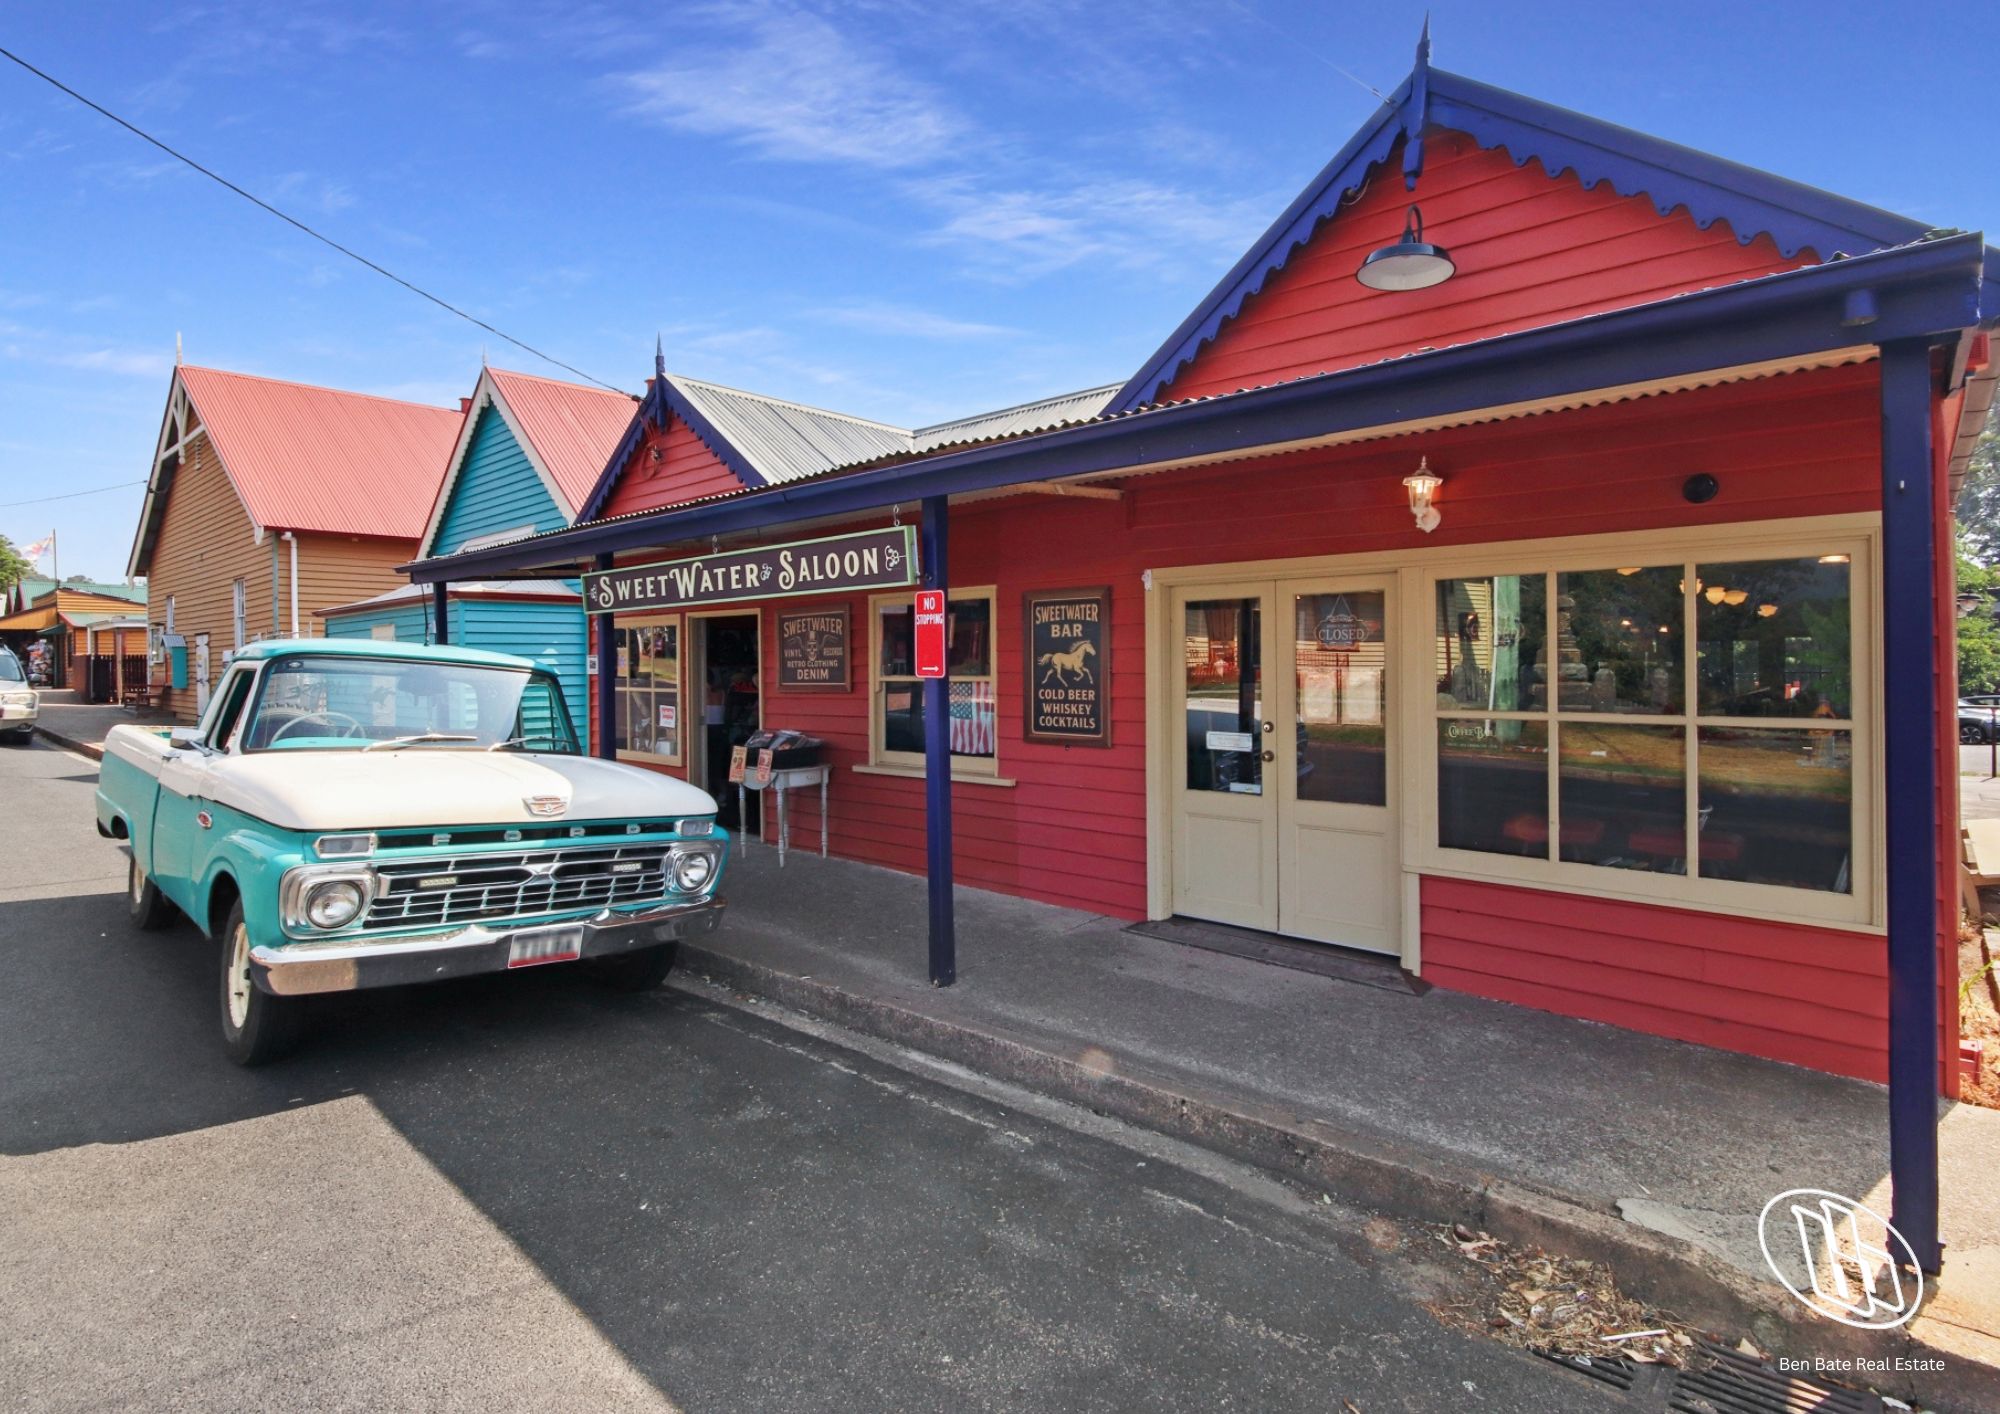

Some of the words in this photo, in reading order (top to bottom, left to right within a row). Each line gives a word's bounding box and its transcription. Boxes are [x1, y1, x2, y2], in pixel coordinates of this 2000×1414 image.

[778, 547, 879, 590] SALOON
[923, 597, 936, 610] NO
[916, 613, 943, 625] STOPPING
[1035, 603, 1099, 624] SWEETWATER
[783, 617, 843, 637] SWEETWATER
[1050, 623, 1083, 638] BAR
[1318, 629, 1365, 641] CLOSED
[783, 648, 802, 657] VINYL
[787, 660, 806, 668] RETRO
[807, 659, 838, 668] CLOTHING
[796, 668, 829, 680] DENIM
[1038, 688, 1065, 700] COLD
[1068, 689, 1096, 701] BEER
[1042, 702, 1092, 715] WHISKEY
[1039, 715, 1096, 729] COCKTAILS
[432, 823, 641, 847] FORD
